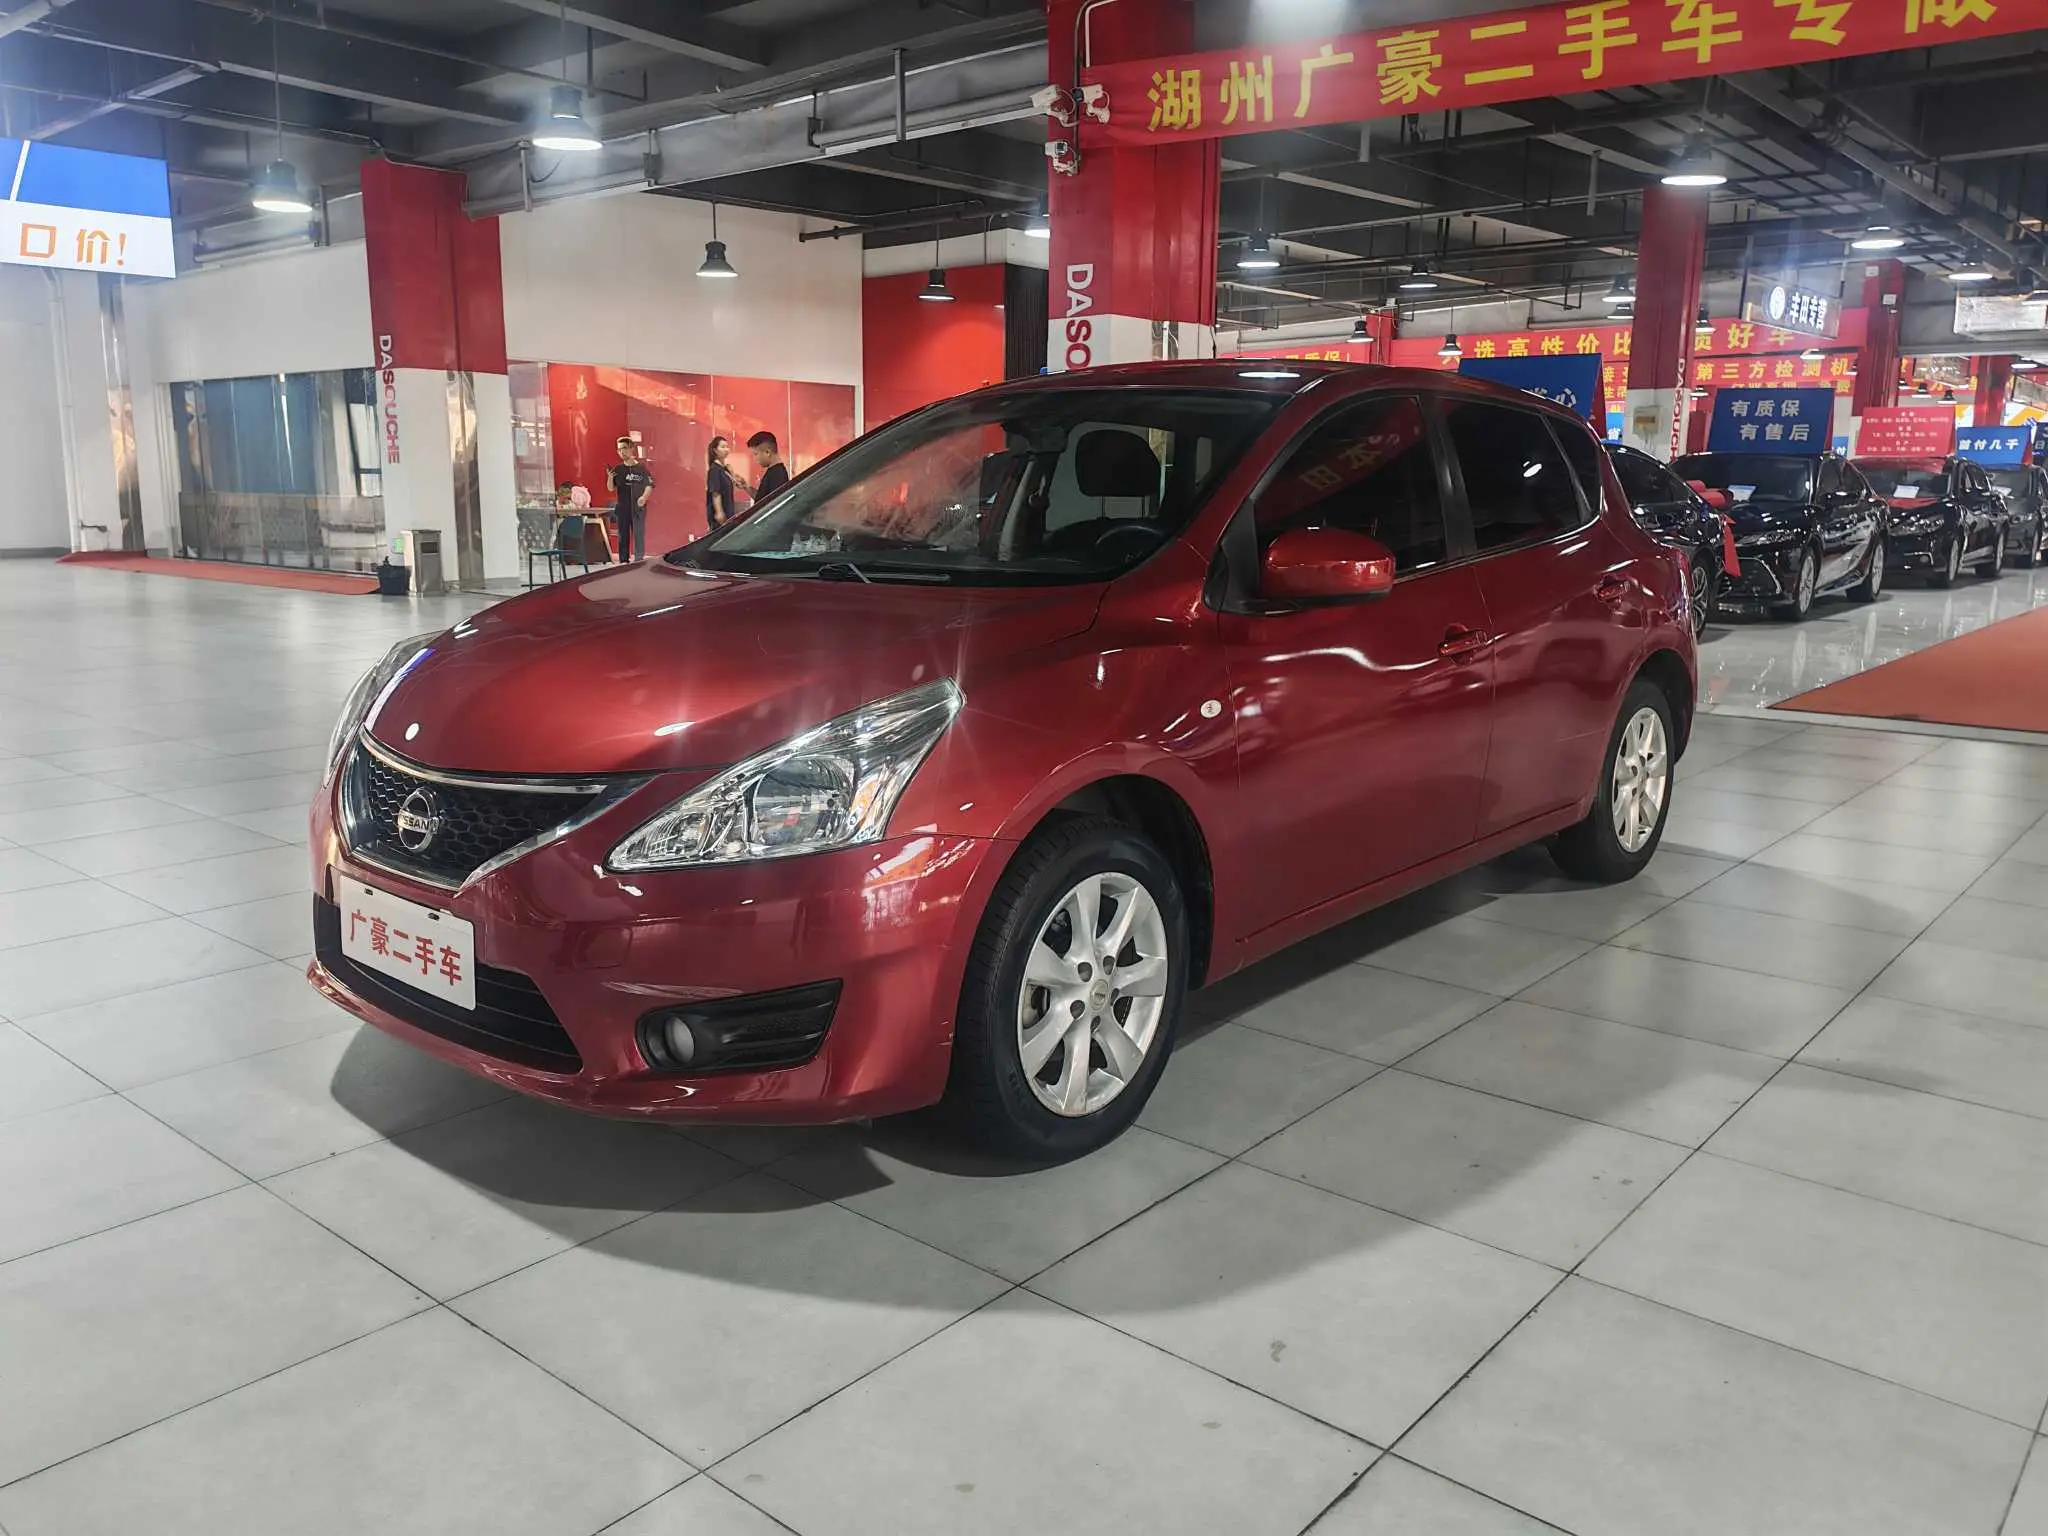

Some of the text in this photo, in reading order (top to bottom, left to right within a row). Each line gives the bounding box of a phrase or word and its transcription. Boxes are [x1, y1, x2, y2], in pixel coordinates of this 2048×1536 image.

[1731, 399, 1801, 417] 有质保
[1740, 423, 1811, 441] 有售后
[1958, 437, 2020, 451] 首付几千
[350, 908, 463, 986] 广豪二手车
